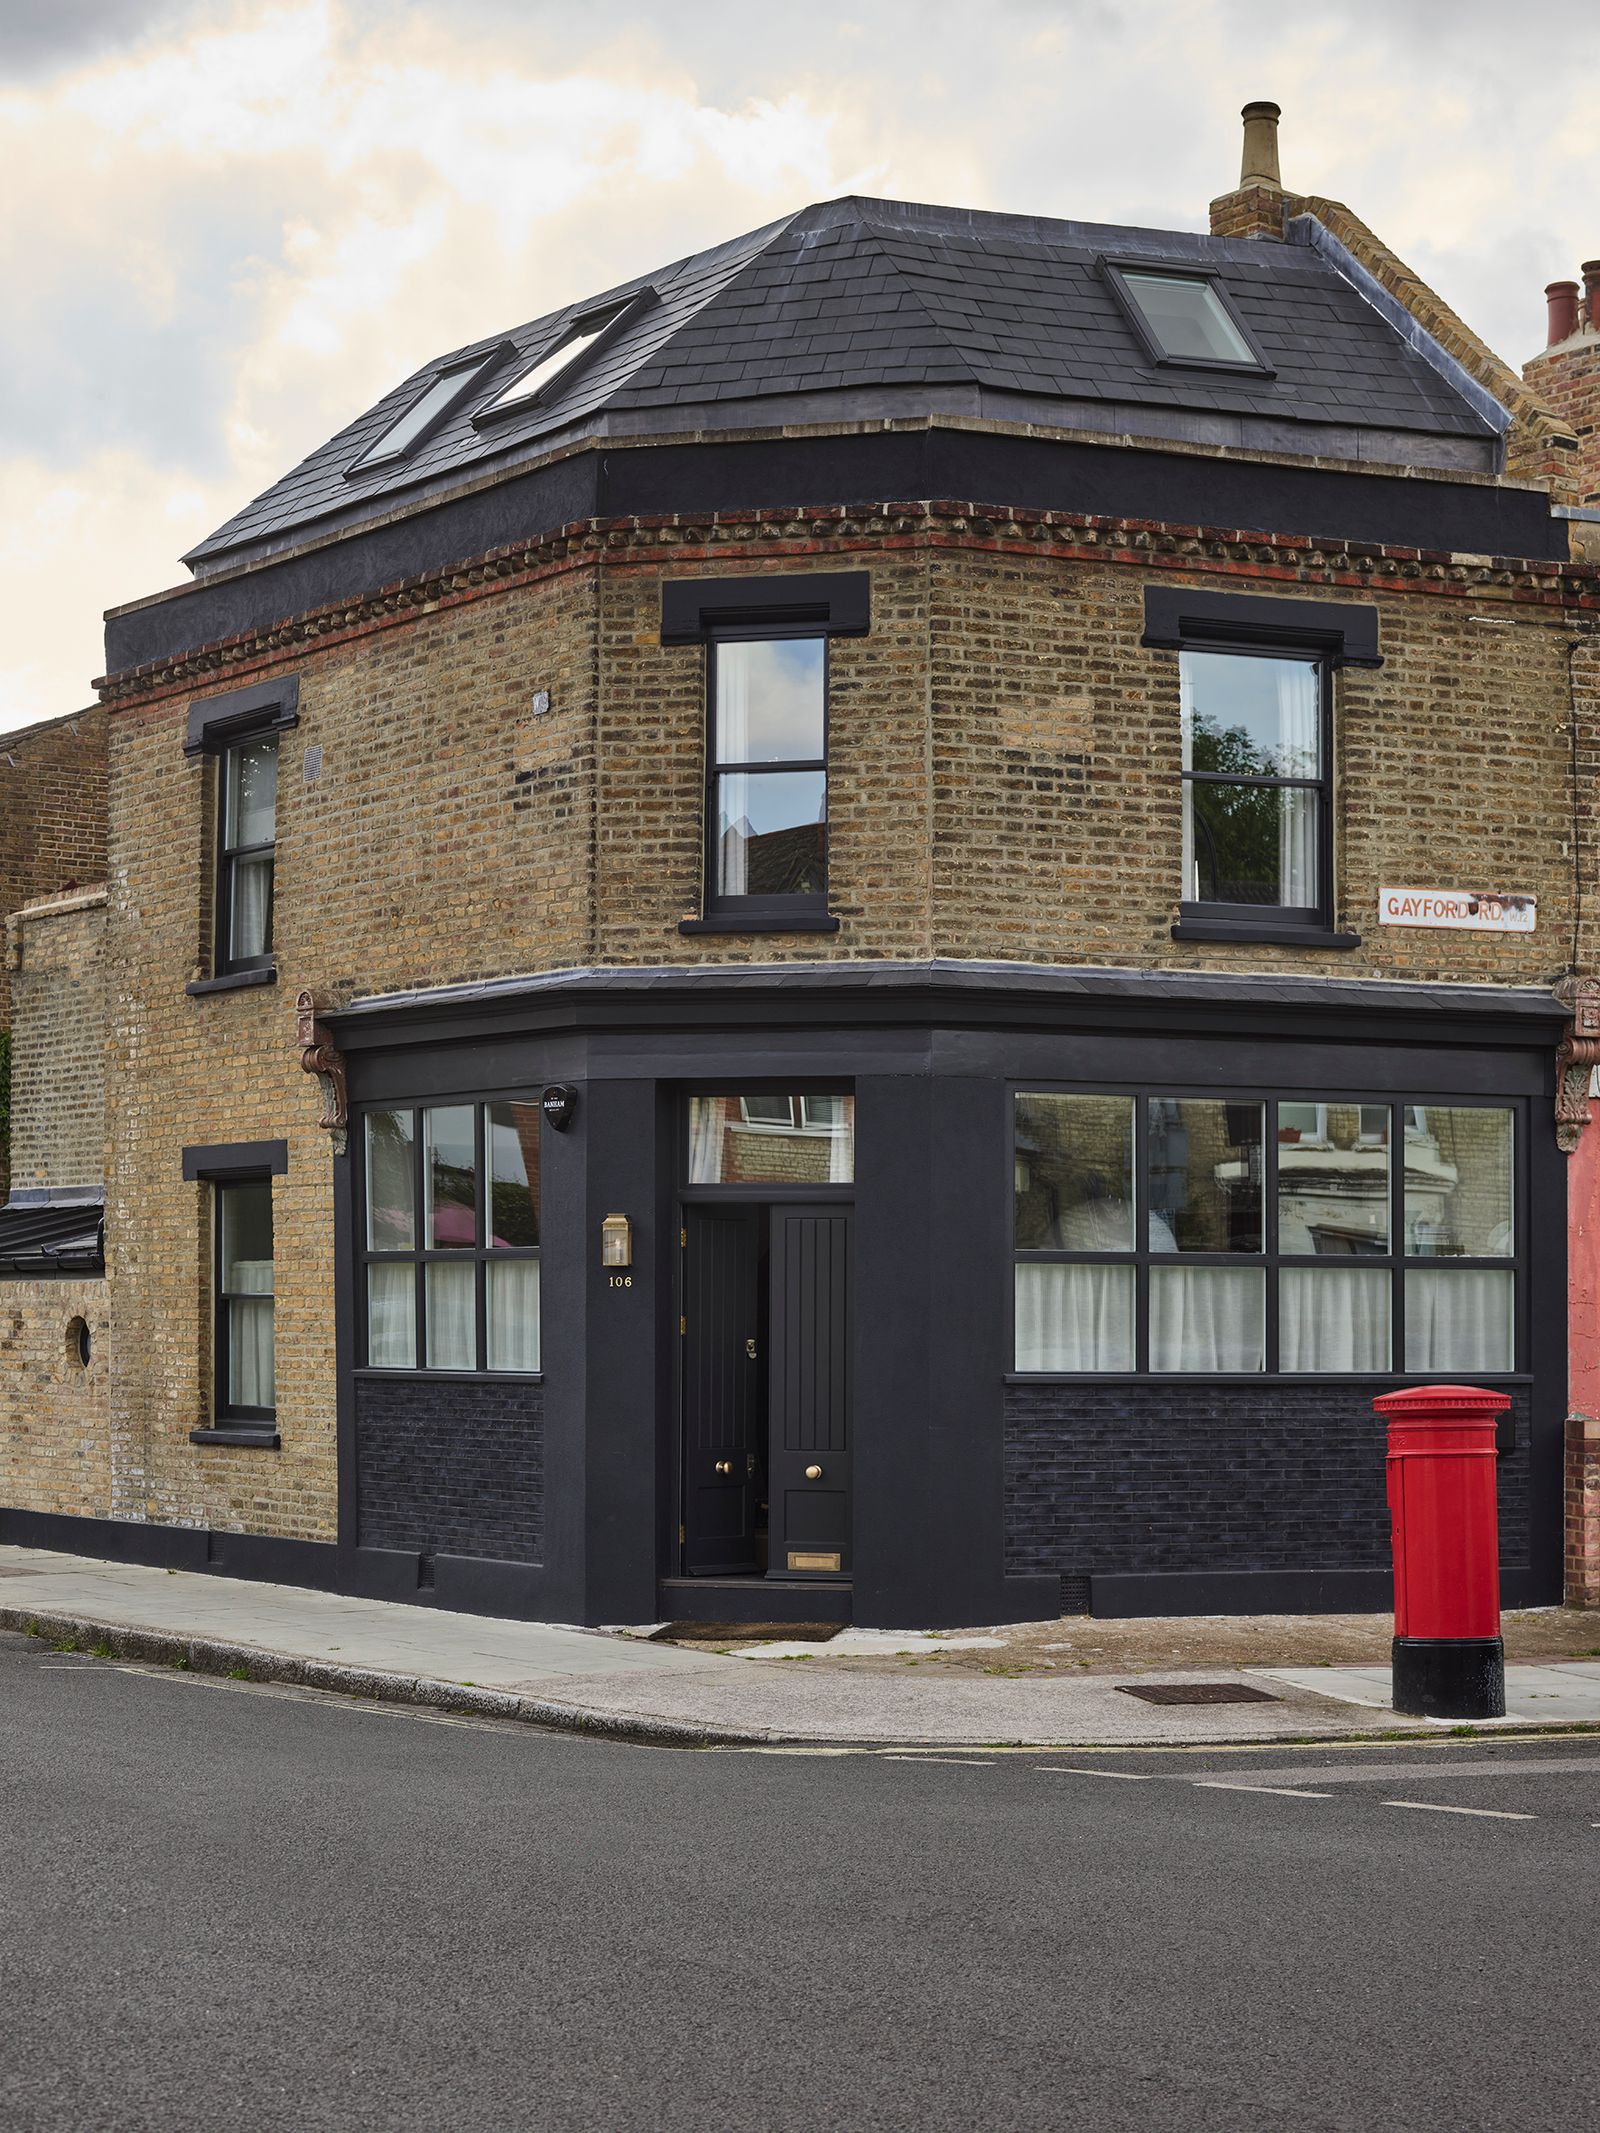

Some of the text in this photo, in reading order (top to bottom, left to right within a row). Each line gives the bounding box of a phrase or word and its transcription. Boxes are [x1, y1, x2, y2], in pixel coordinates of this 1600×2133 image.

[1387, 897, 1468, 919] GAYFORD
[1479, 900, 1504, 921] RD.
[543, 1100, 565, 1108] BANHAM
[609, 1276, 632, 1287] 106
